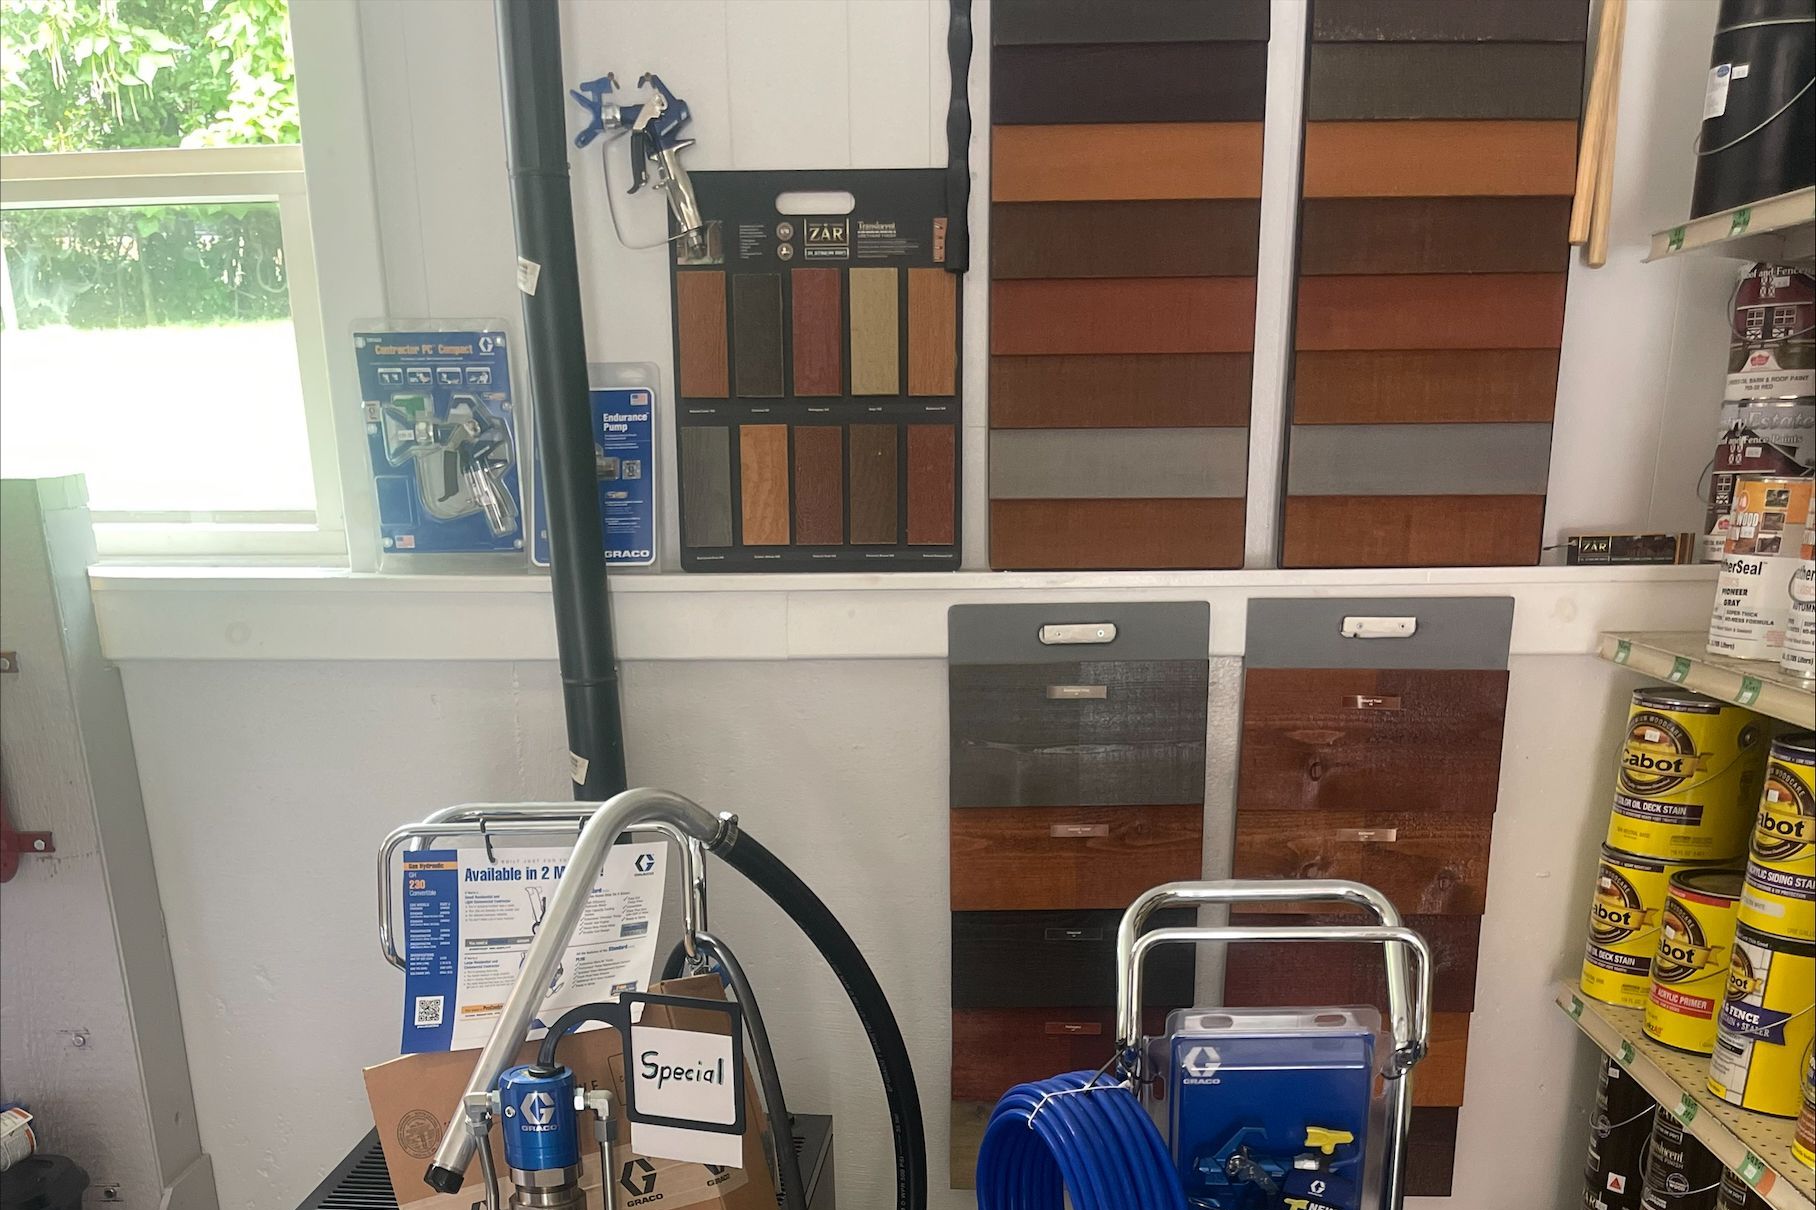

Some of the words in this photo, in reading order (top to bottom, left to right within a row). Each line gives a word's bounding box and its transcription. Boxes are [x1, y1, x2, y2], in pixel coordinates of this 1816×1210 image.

[809, 227, 844, 241] ZAR
[375, 345, 420, 355] Contractor
[438, 344, 473, 356] Compact
[603, 423, 628, 433] Pump
[1583, 541, 1607, 551] ZAR
[604, 550, 650, 559] GRACO
[1724, 599, 1741, 607] GRAY
[1622, 748, 1684, 773] Cabot
[1643, 802, 1661, 813] DECK
[1662, 805, 1687, 816] STAIN
[1758, 813, 1804, 838] abot
[420, 862, 445, 870] Hydraulic
[465, 867, 522, 882] Available
[526, 867, 537, 880] in
[541, 866, 550, 880] 2
[1767, 872, 1793, 887] SIDING
[1794, 877, 1815, 889] STAI
[408, 879, 426, 890] 230
[1592, 904, 1631, 926] abot
[1599, 949, 1614, 962] DECK
[1615, 954, 1636, 967] STAIN
[1730, 976, 1748, 990] bot
[1658, 989, 1679, 1003] ACRYLIC
[1680, 994, 1708, 1010] PRIMER
[1730, 1006, 1760, 1026] FENCE
[641, 1051, 725, 1090] Special
[521, 1125, 557, 1133] GRACO
[627, 1193, 664, 1208] GRACO
